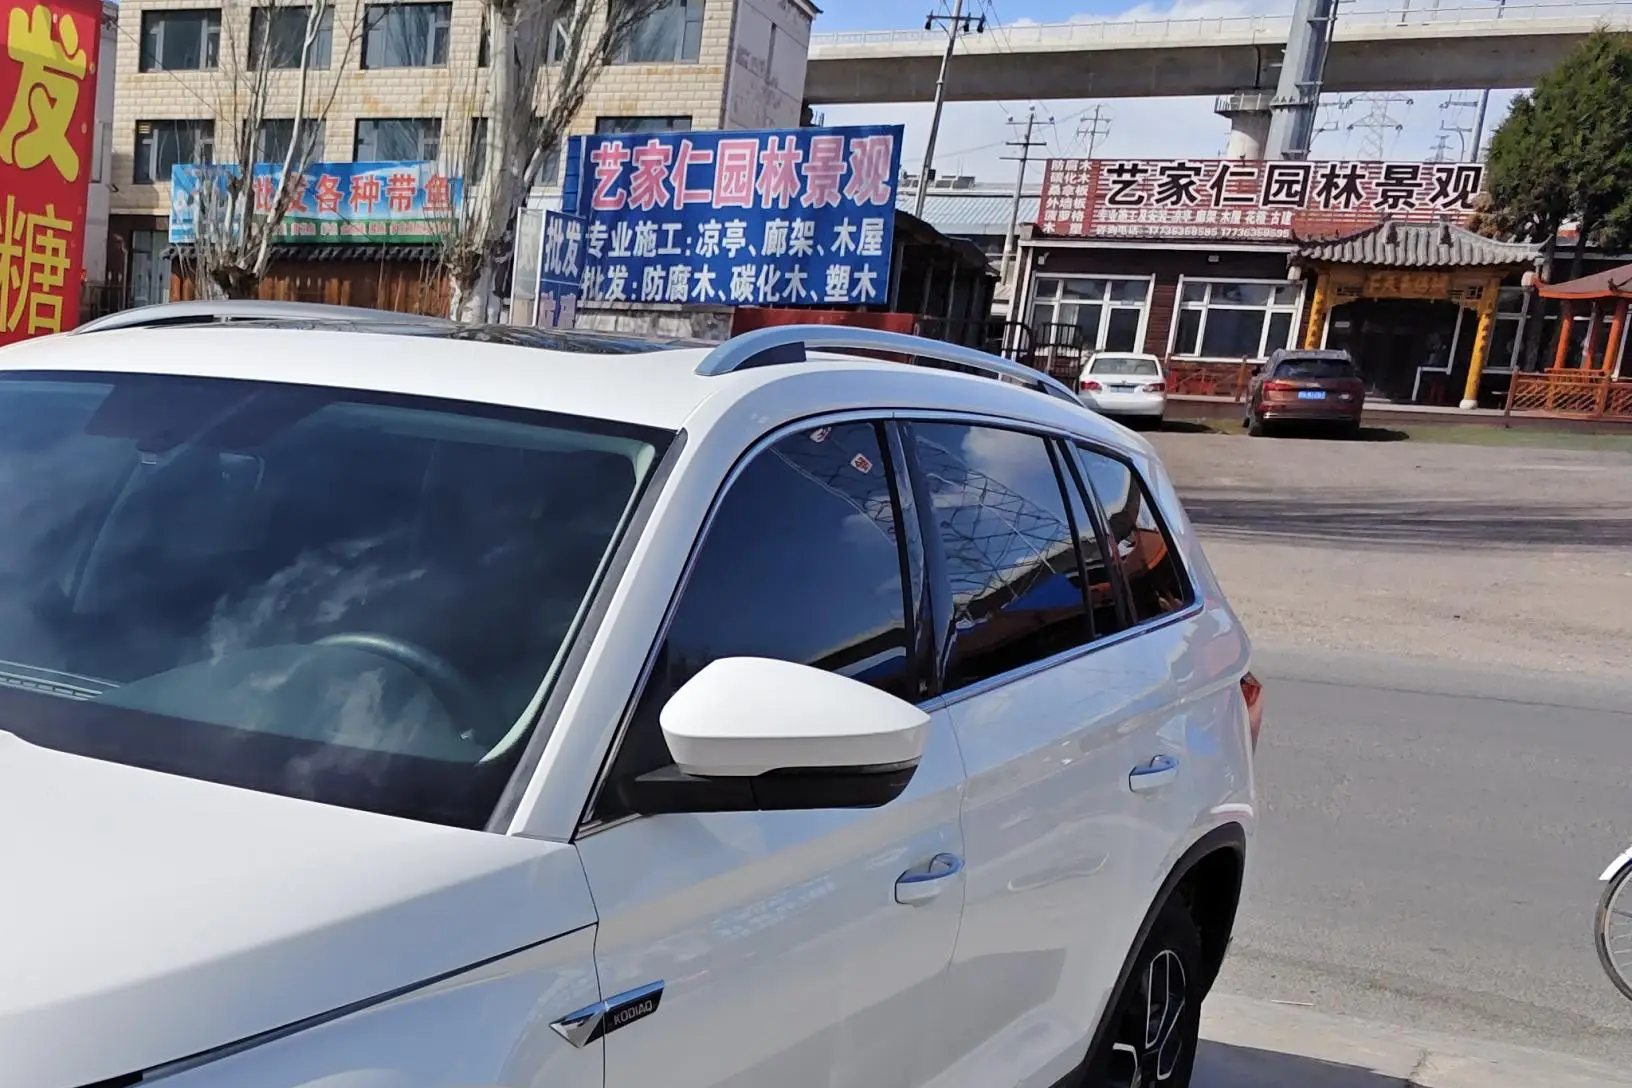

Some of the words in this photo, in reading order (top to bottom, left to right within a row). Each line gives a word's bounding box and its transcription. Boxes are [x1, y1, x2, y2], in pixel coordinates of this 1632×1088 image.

[590, 135, 894, 211] 艺家仁园林景观
[1104, 160, 1483, 211] 艺家仁园林景观
[544, 215, 582, 278] 批发
[613, 1000, 654, 1026] KODIAQ
